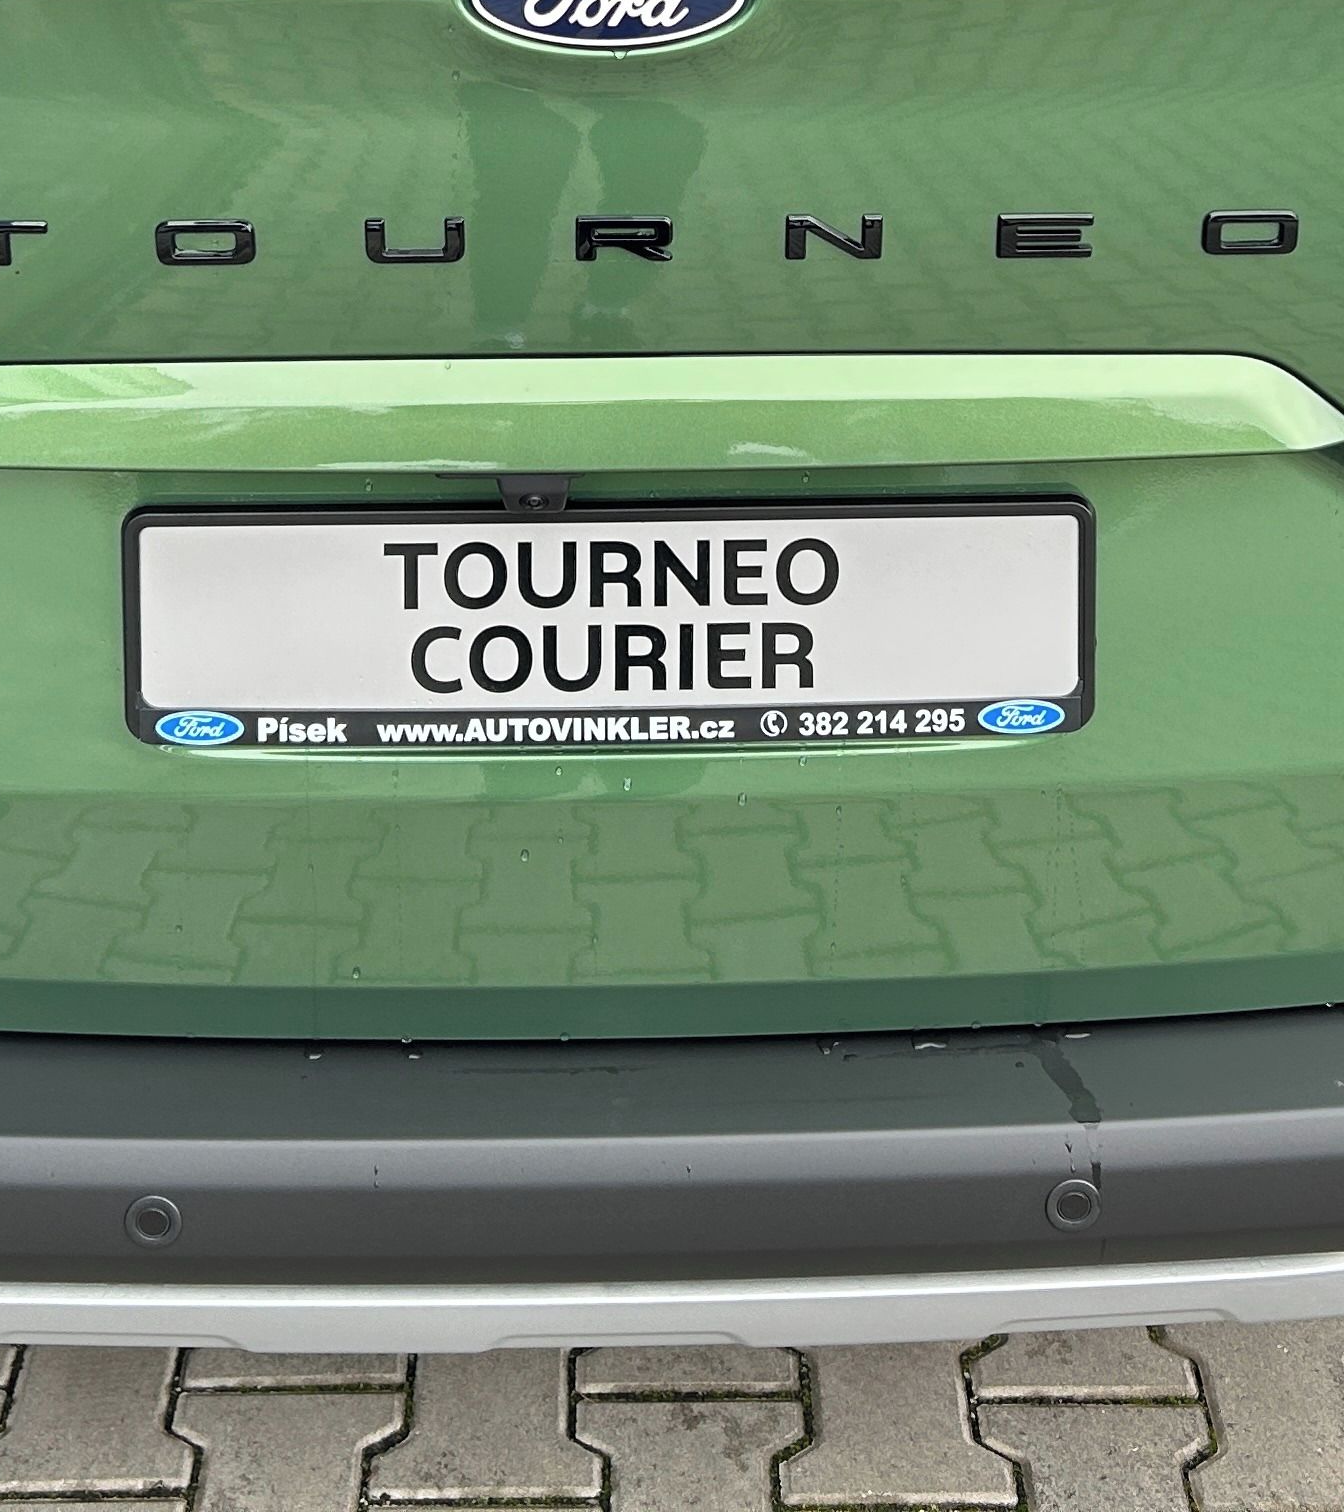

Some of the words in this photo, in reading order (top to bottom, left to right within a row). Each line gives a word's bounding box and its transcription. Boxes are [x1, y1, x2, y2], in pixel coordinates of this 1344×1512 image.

[383, 537, 840, 610] TOURNEO
[410, 622, 814, 694] COURIER
[257, 716, 348, 743] Písek
[376, 715, 735, 743] www.AUTOVINKLER.cz
[798, 711, 849, 737] 382
[856, 709, 908, 735] 214
[914, 708, 966, 733] 295
